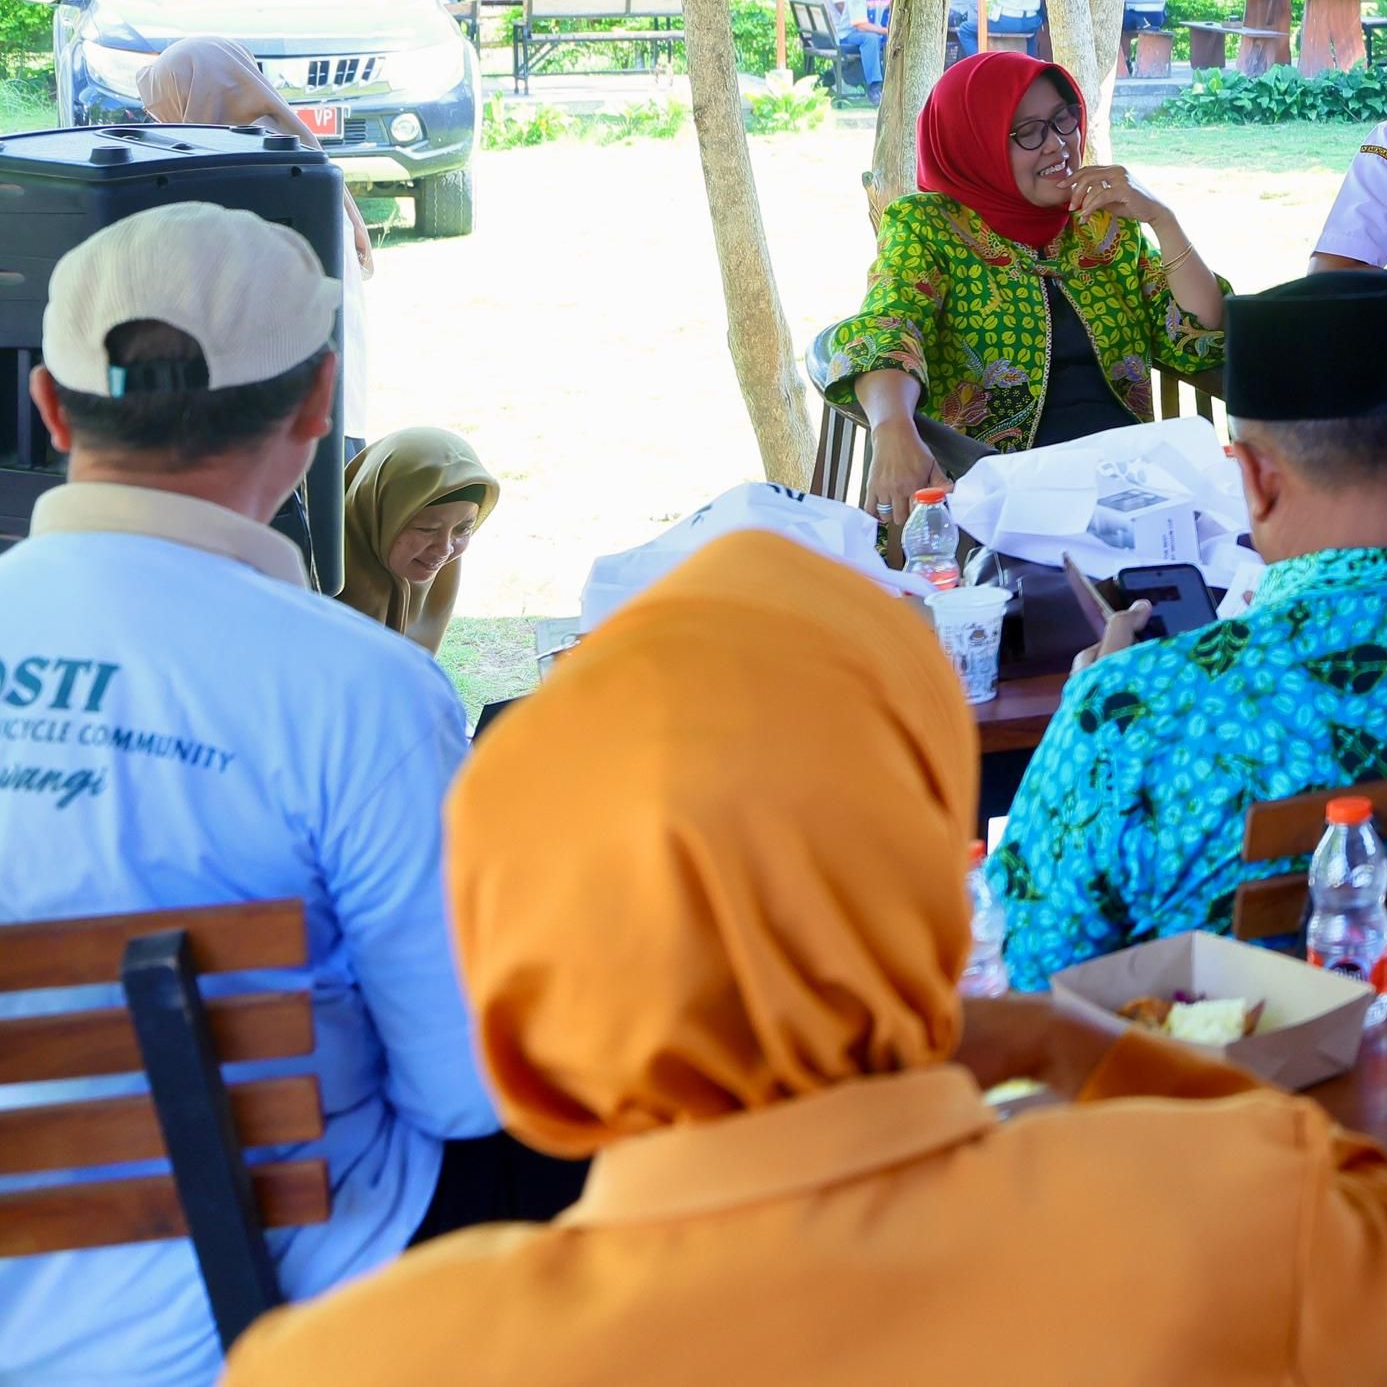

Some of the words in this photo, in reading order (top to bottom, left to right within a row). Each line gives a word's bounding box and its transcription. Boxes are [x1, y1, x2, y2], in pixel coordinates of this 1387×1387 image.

[314, 109, 333, 126] VP
[0, 656, 120, 712] STI
[78, 724, 236, 773] COMMUNITY
